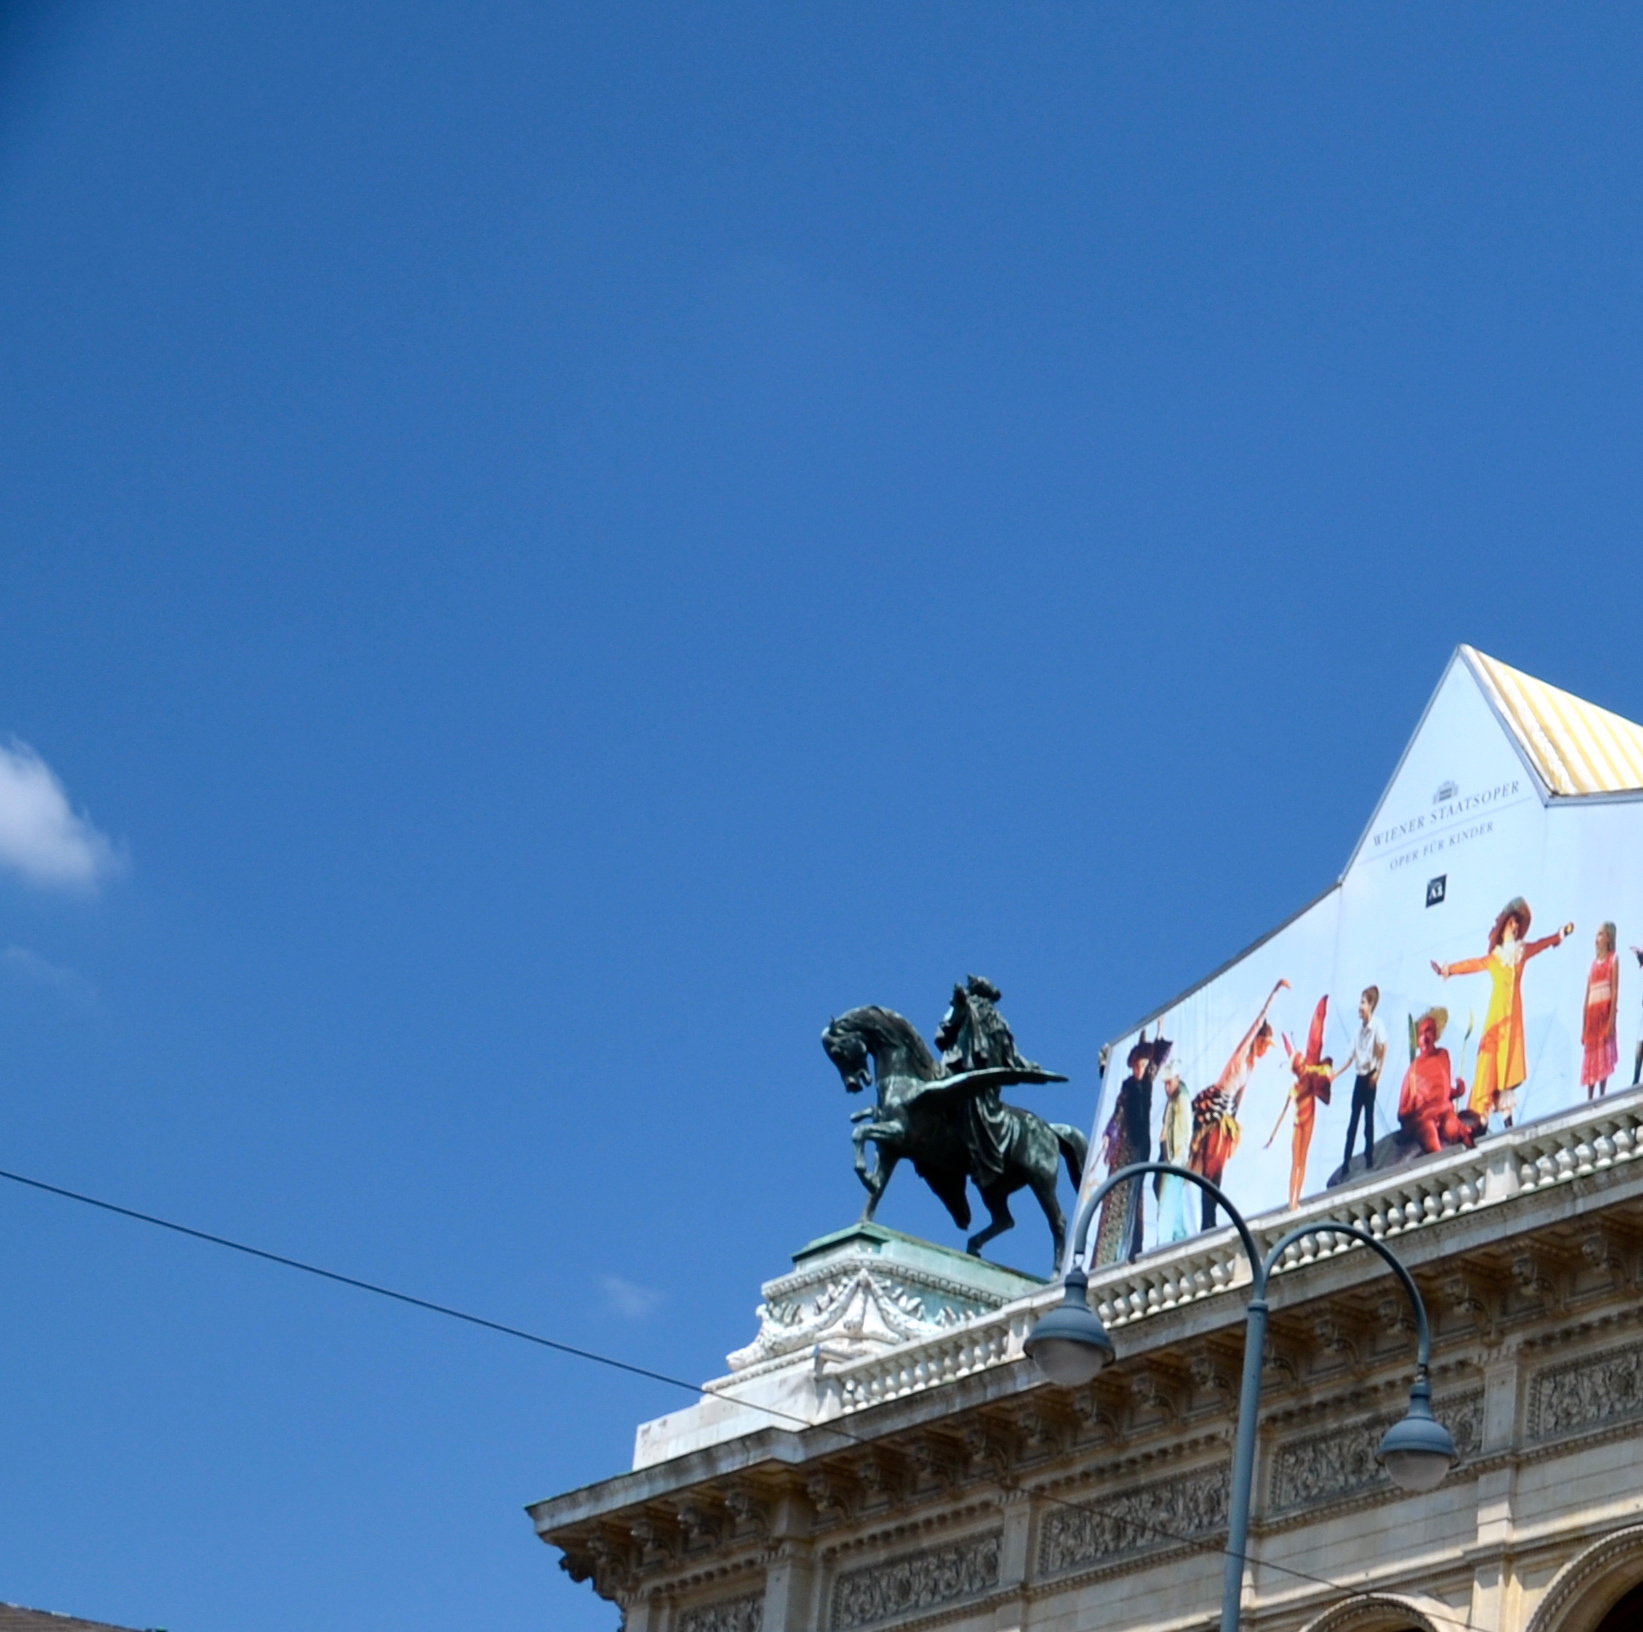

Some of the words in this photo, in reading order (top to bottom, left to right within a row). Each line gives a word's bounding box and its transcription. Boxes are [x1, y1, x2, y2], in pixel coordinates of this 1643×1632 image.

[1373, 816, 1425, 847] WIENER
[1430, 780, 1520, 824] STAATSOPER
[1389, 849, 1419, 870] OPER
[1449, 821, 1494, 847] KINDER
